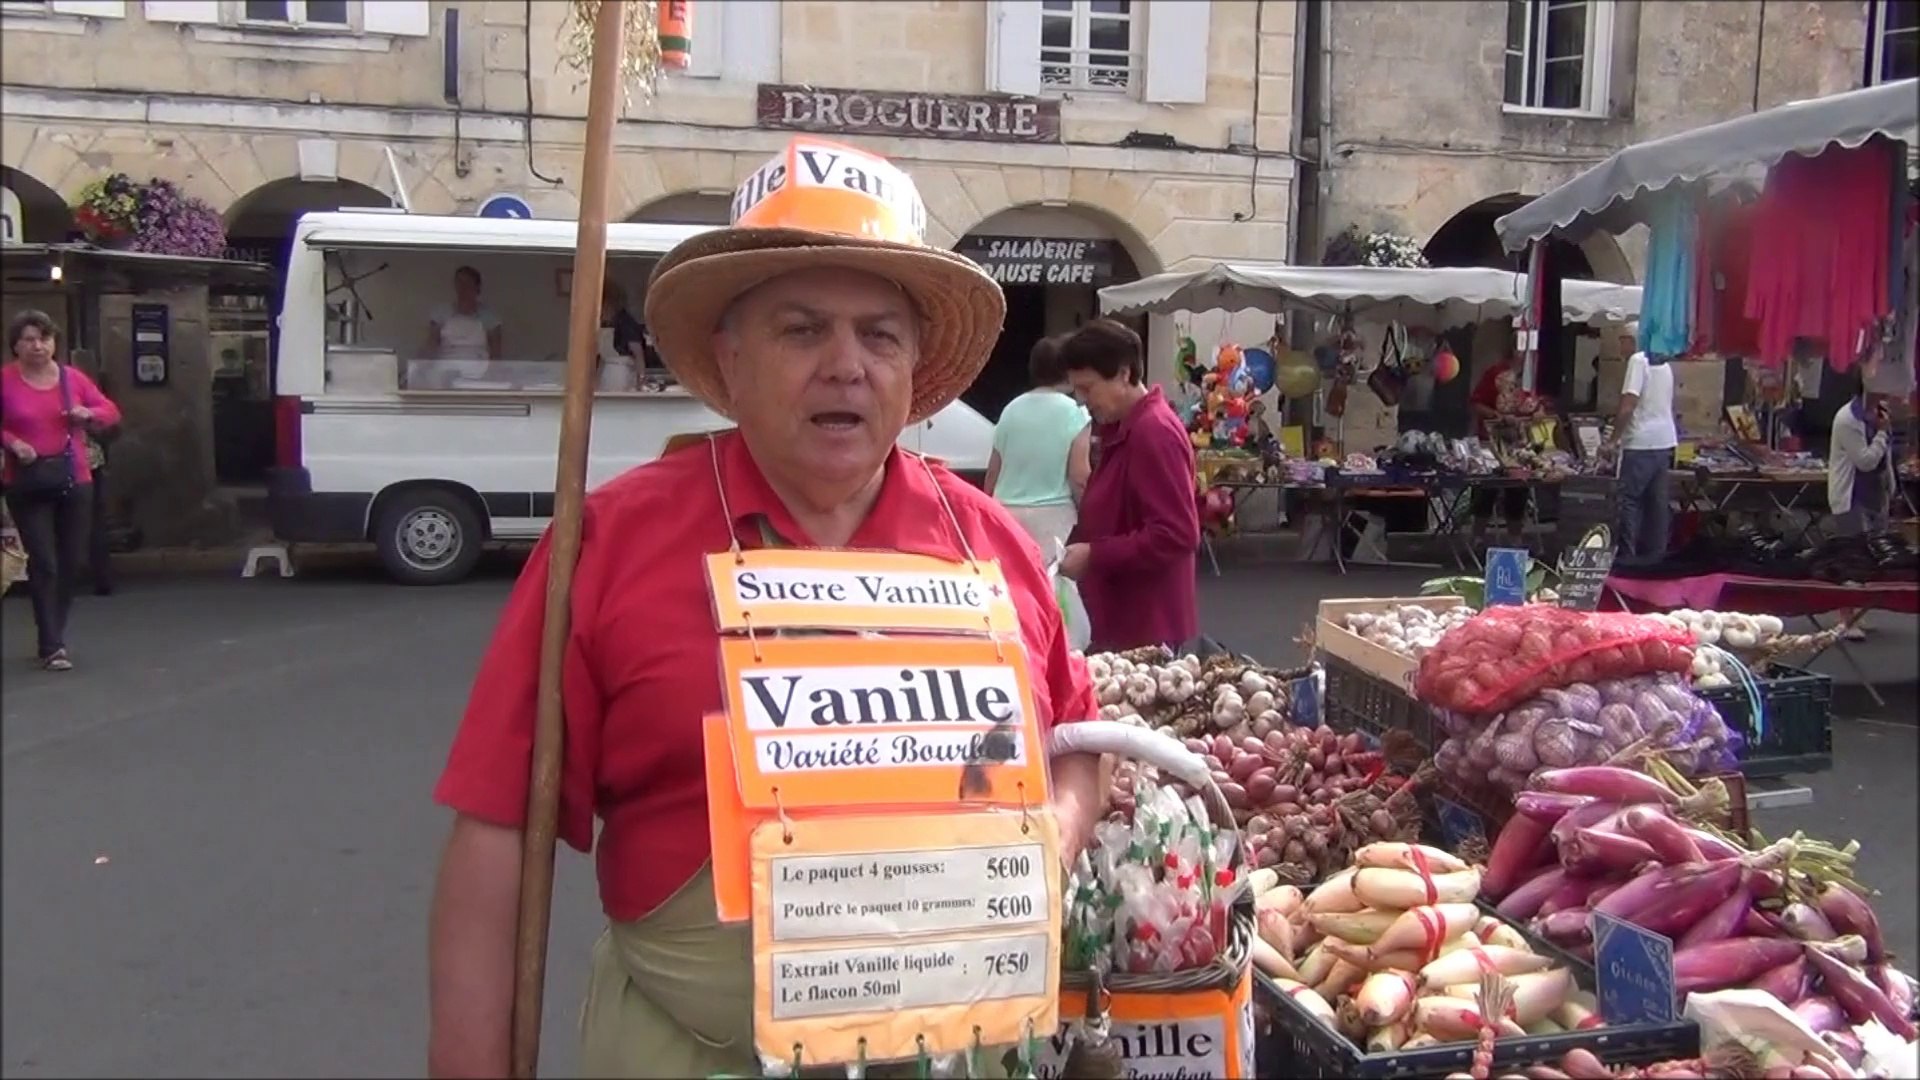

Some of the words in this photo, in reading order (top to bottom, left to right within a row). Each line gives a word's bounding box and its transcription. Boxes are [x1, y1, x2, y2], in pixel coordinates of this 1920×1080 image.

[780, 91, 1038, 136] DROGUERIE
[1046, 264, 1095, 283] CAFE
[737, 572, 847, 601] Sucre
[856, 576, 981, 607] Vanillé
[741, 669, 1013, 728] Vanille
[766, 737, 881, 770] Variété
[890, 732, 1021, 765] Bourb
[783, 866, 804, 882] Le
[808, 863, 864, 884] paquet
[869, 861, 880, 878] 4
[883, 862, 945, 880] gousses:
[986, 856, 1030, 879] 5€00
[784, 901, 843, 918] Poudre
[847, 903, 858, 915] le
[861, 900, 904, 917] paquet
[907, 899, 919, 911] 10
[986, 895, 1033, 919] 5€00
[781, 961, 840, 979] Extrait
[845, 956, 900, 974] Vanille
[904, 952, 955, 974] liquide
[984, 951, 1029, 976] 7€50
[782, 986, 803, 1003] Le
[808, 984, 858, 1001] flacon
[862, 978, 901, 997] 50ml
[1052, 1021, 1213, 1058] Vnille
